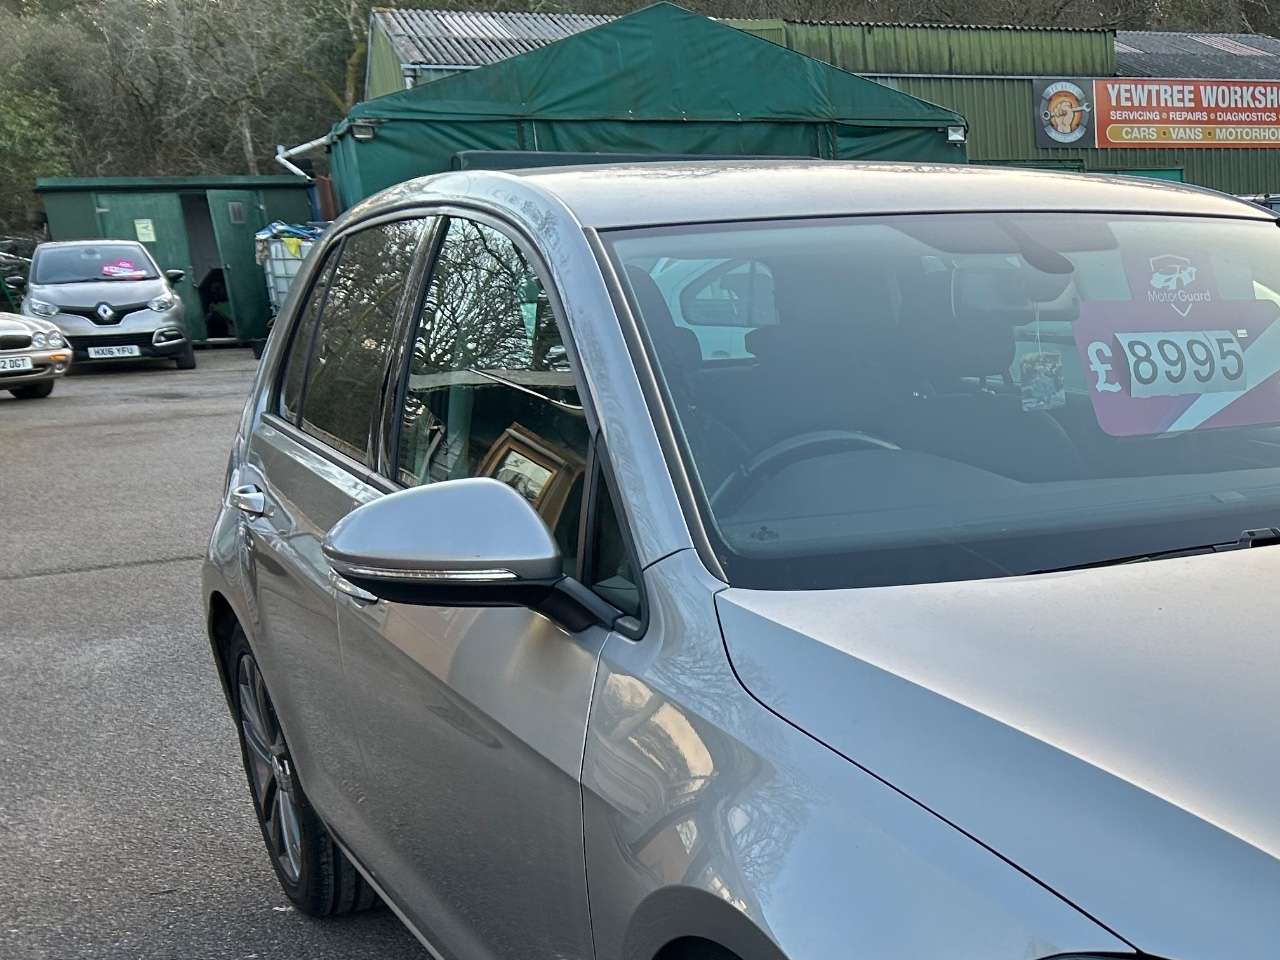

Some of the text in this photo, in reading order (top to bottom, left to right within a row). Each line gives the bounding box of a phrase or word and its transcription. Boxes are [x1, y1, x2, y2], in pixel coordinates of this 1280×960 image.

[1107, 84, 1195, 107] YEWTREE
[1110, 111, 1160, 121] SERVICING
[1169, 111, 1208, 121] REPAIRS
[1216, 112, 1278, 121] DIAGNOSTICS
[1122, 127, 1158, 140] CARS
[1169, 127, 1203, 140] VANS
[1147, 289, 1212, 303] MotorGuard
